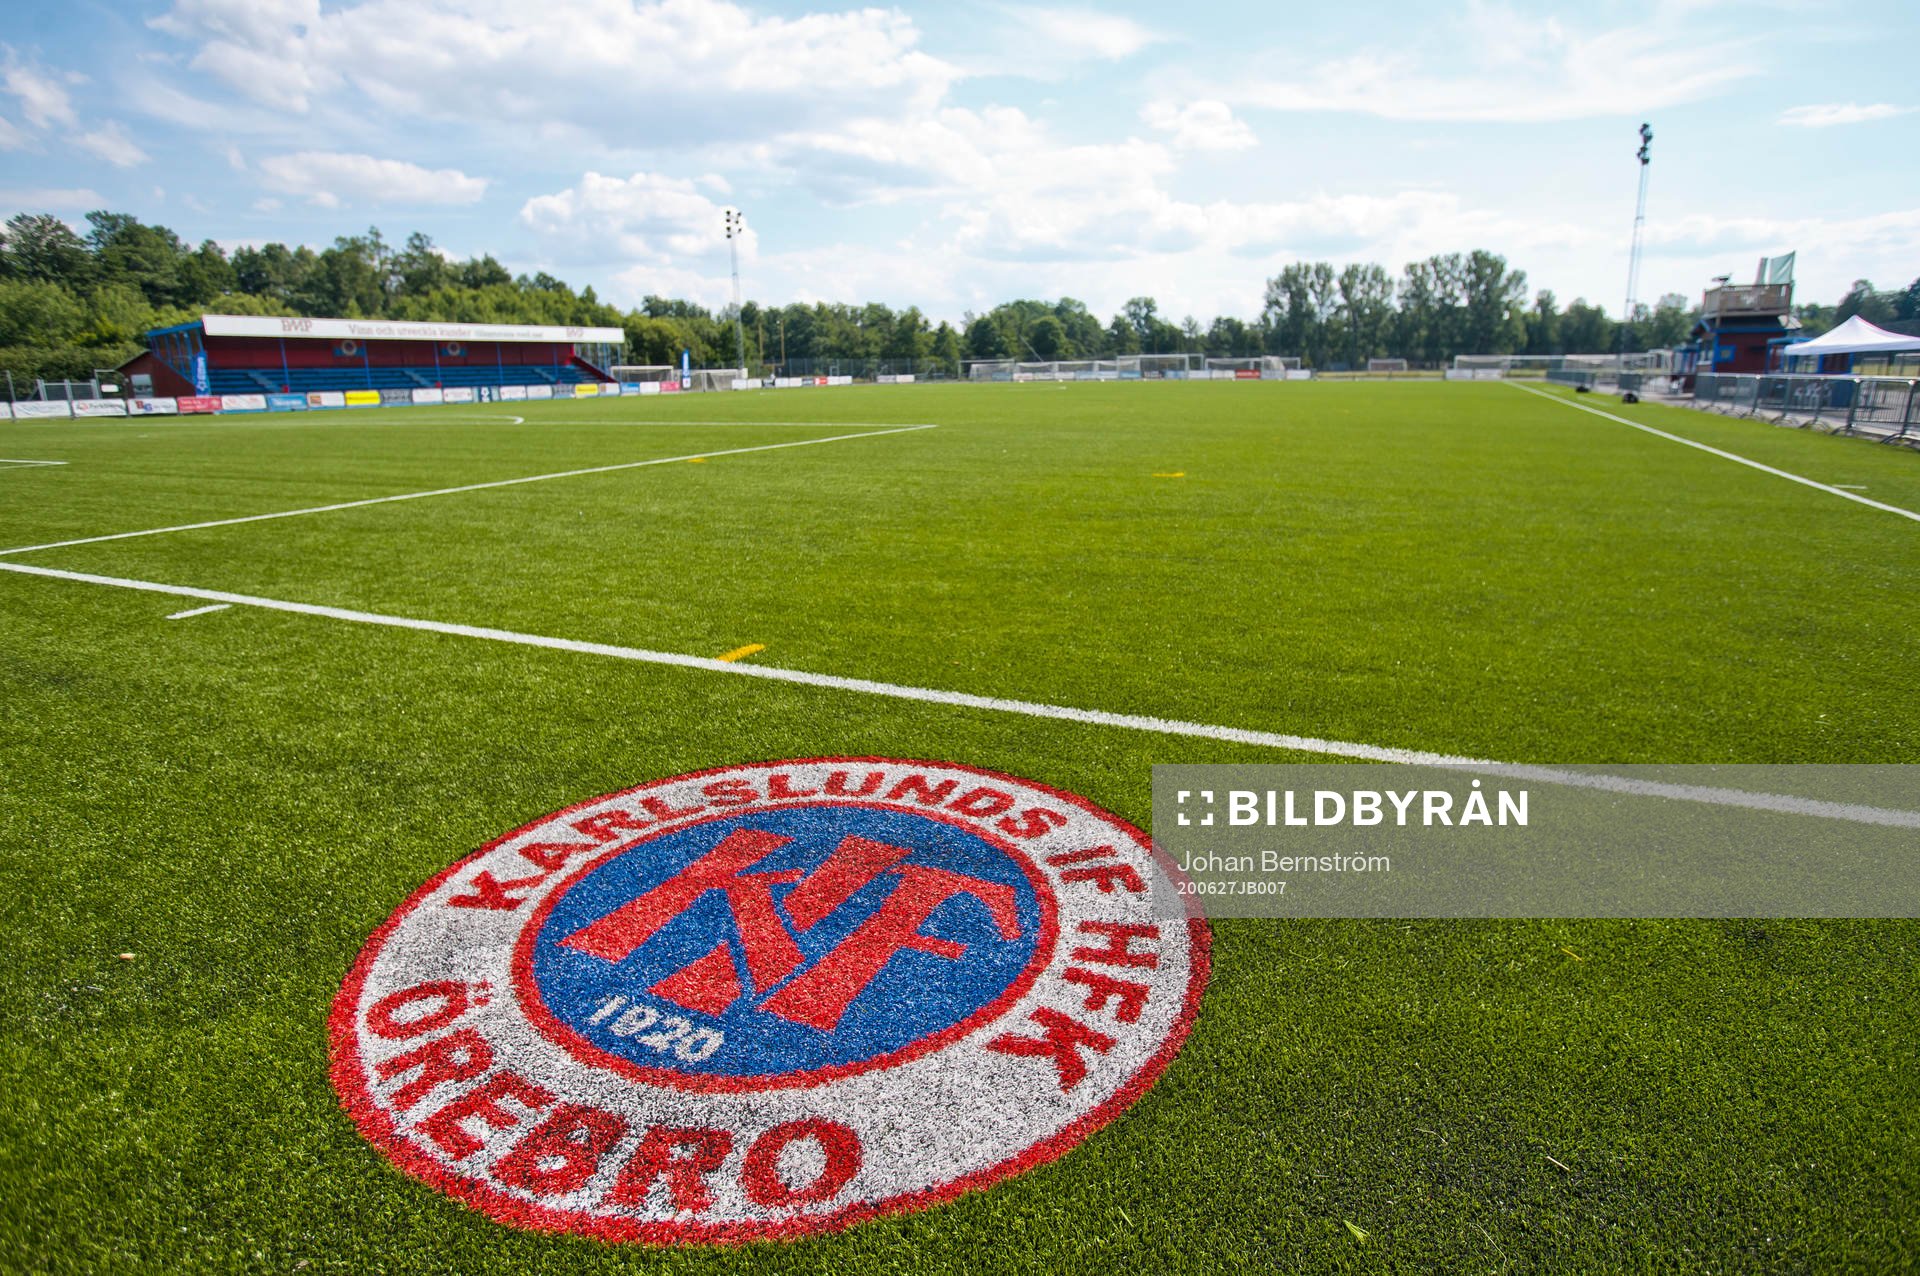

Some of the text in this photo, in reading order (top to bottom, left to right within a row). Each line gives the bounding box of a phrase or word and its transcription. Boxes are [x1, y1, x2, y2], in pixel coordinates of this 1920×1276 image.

[447, 771, 1161, 1094] KARLSLUNDS IF HFK
[587, 995, 726, 1063] 1920
[365, 978, 864, 1213] ÖREBRO
